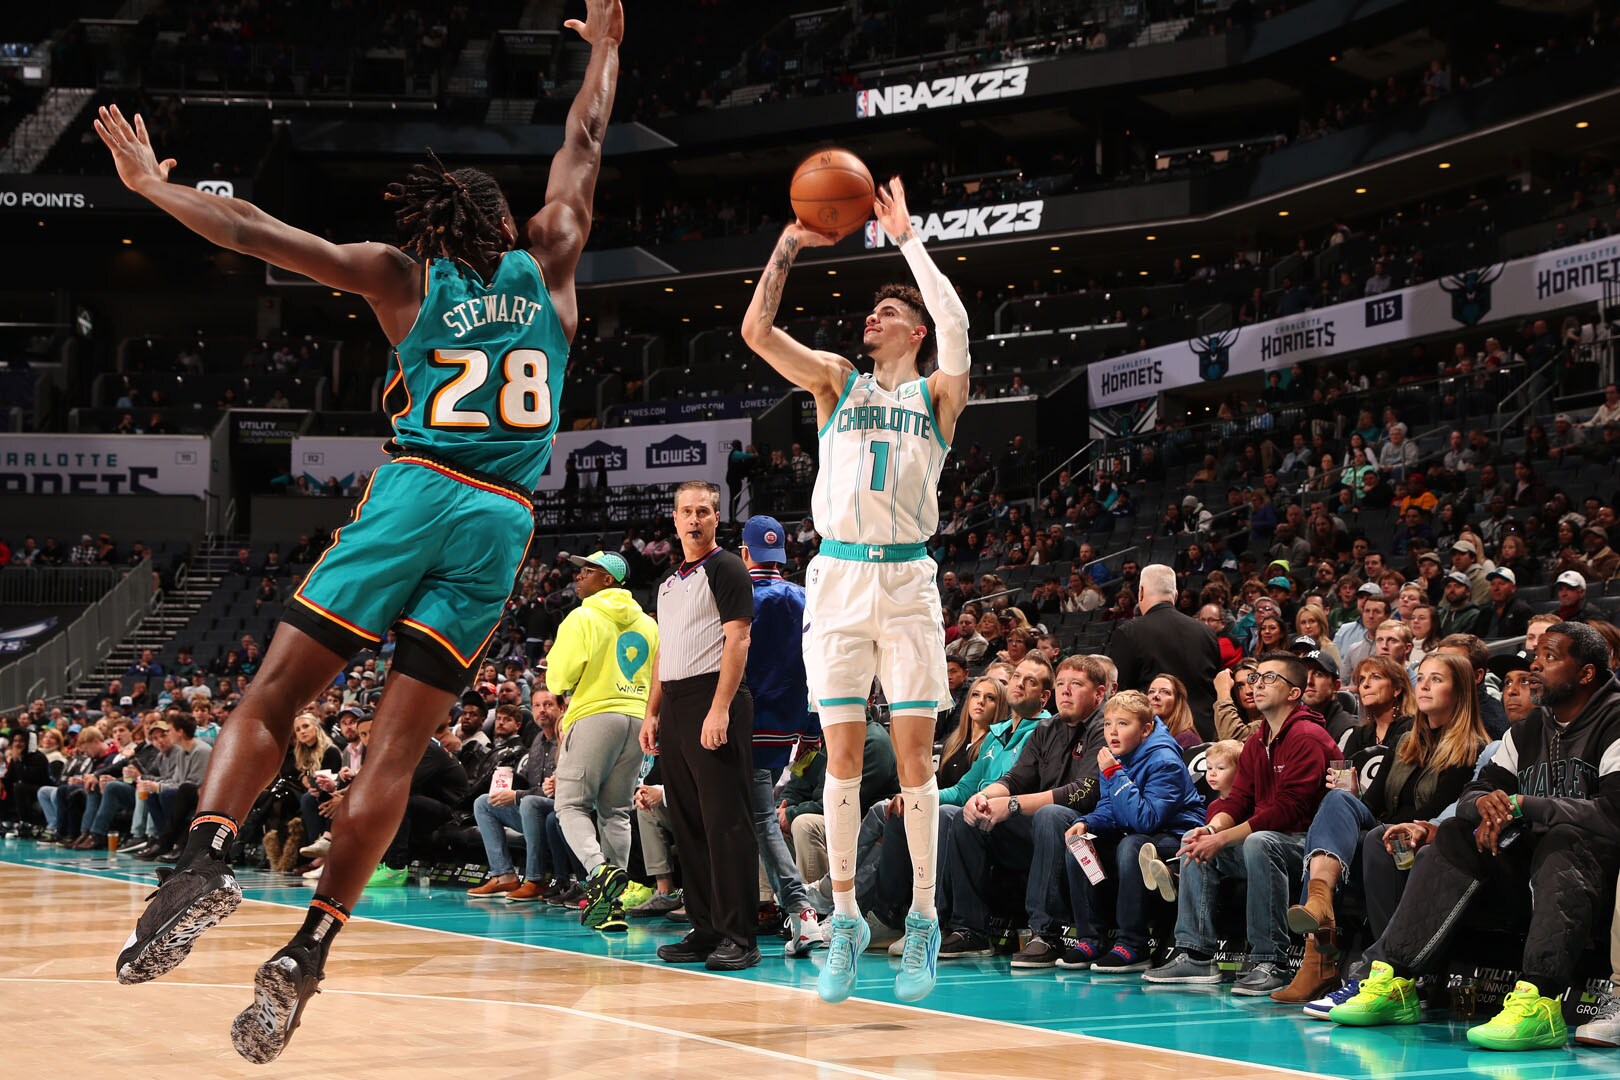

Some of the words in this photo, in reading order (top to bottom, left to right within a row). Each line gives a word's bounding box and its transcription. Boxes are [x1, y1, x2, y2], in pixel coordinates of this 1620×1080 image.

[0, 192, 18, 207] O
[22, 192, 86, 209] POINTS
[1556, 246, 1618, 268] CHARLOTTE
[442, 293, 542, 338] STEWART
[1372, 299, 1396, 322] 113
[1274, 317, 1321, 335] CHARLOTTE
[1261, 321, 1336, 362] HORNETS
[1112, 357, 1151, 373] CHARLOTTE
[1101, 361, 1163, 396] HORNETS
[423, 347, 552, 433] 28
[239, 420, 277, 429] UTILITY
[836, 405, 931, 440] CHARLOTTE
[652, 446, 701, 465] LOWE'S
[870, 440, 889, 492] 1
[616, 682, 646, 695] WAVE
[1473, 966, 1523, 982] UTILITY
